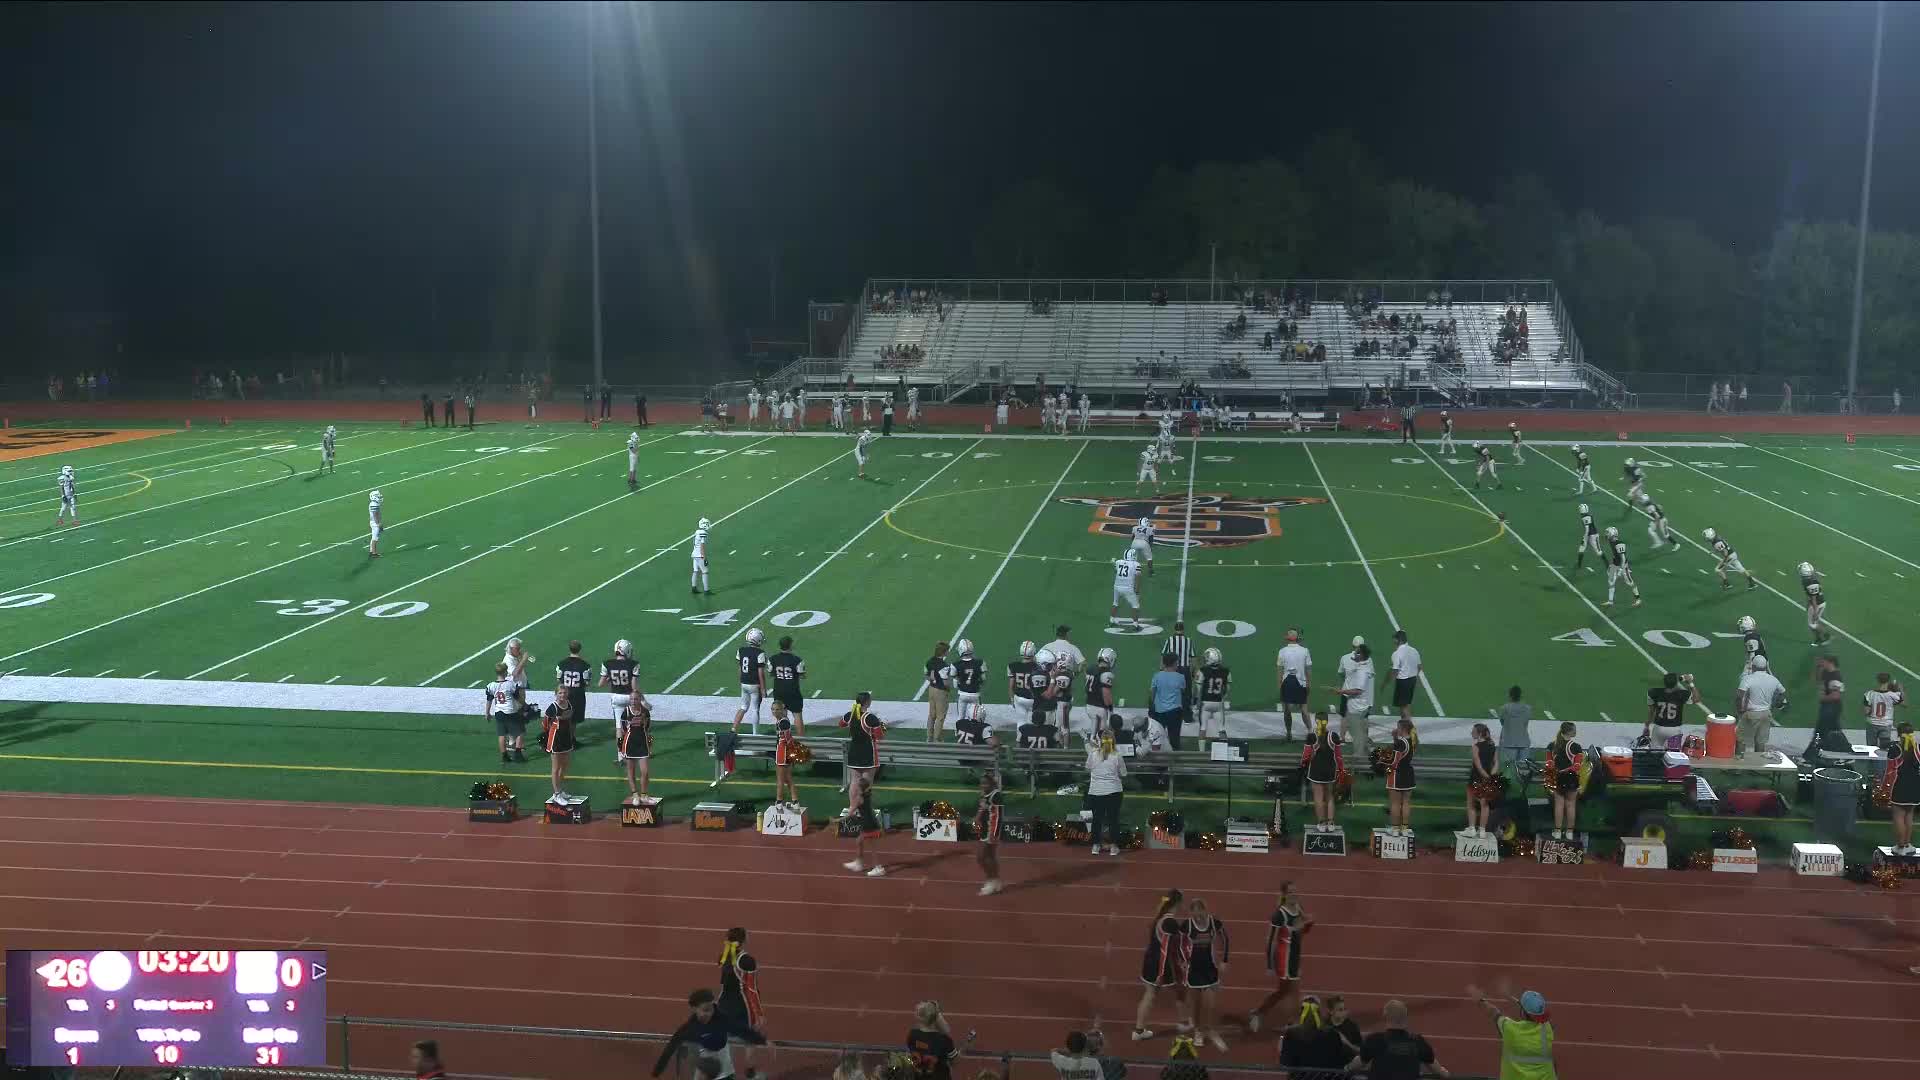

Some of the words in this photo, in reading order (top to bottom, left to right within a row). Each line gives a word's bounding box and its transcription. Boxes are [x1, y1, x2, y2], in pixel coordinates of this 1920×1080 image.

[1118, 565, 1129, 578] 73
[276, 598, 430, 618] 30
[680, 608, 832, 627] 40
[1551, 627, 1711, 649] 40
[742, 657, 749, 673] 8
[564, 671, 581, 687] 62
[610, 670, 629, 686] 58
[965, 669, 975, 685] 7
[1208, 677, 1223, 694] 13
[1657, 701, 1677, 720] 76
[1308, 836, 1337, 850] Ava
[1383, 842, 1406, 853] BELLA
[1636, 849, 1649, 865] J
[138, 951, 229, 973] 03:20
[47, 959, 88, 988] 26
[281, 958, 303, 988] 0
[105, 1000, 115, 1010] 3
[285, 1000, 295, 1010] 3
[66, 1047, 78, 1065] 1
[154, 1046, 178, 1064] 10
[256, 1046, 280, 1065] 31
